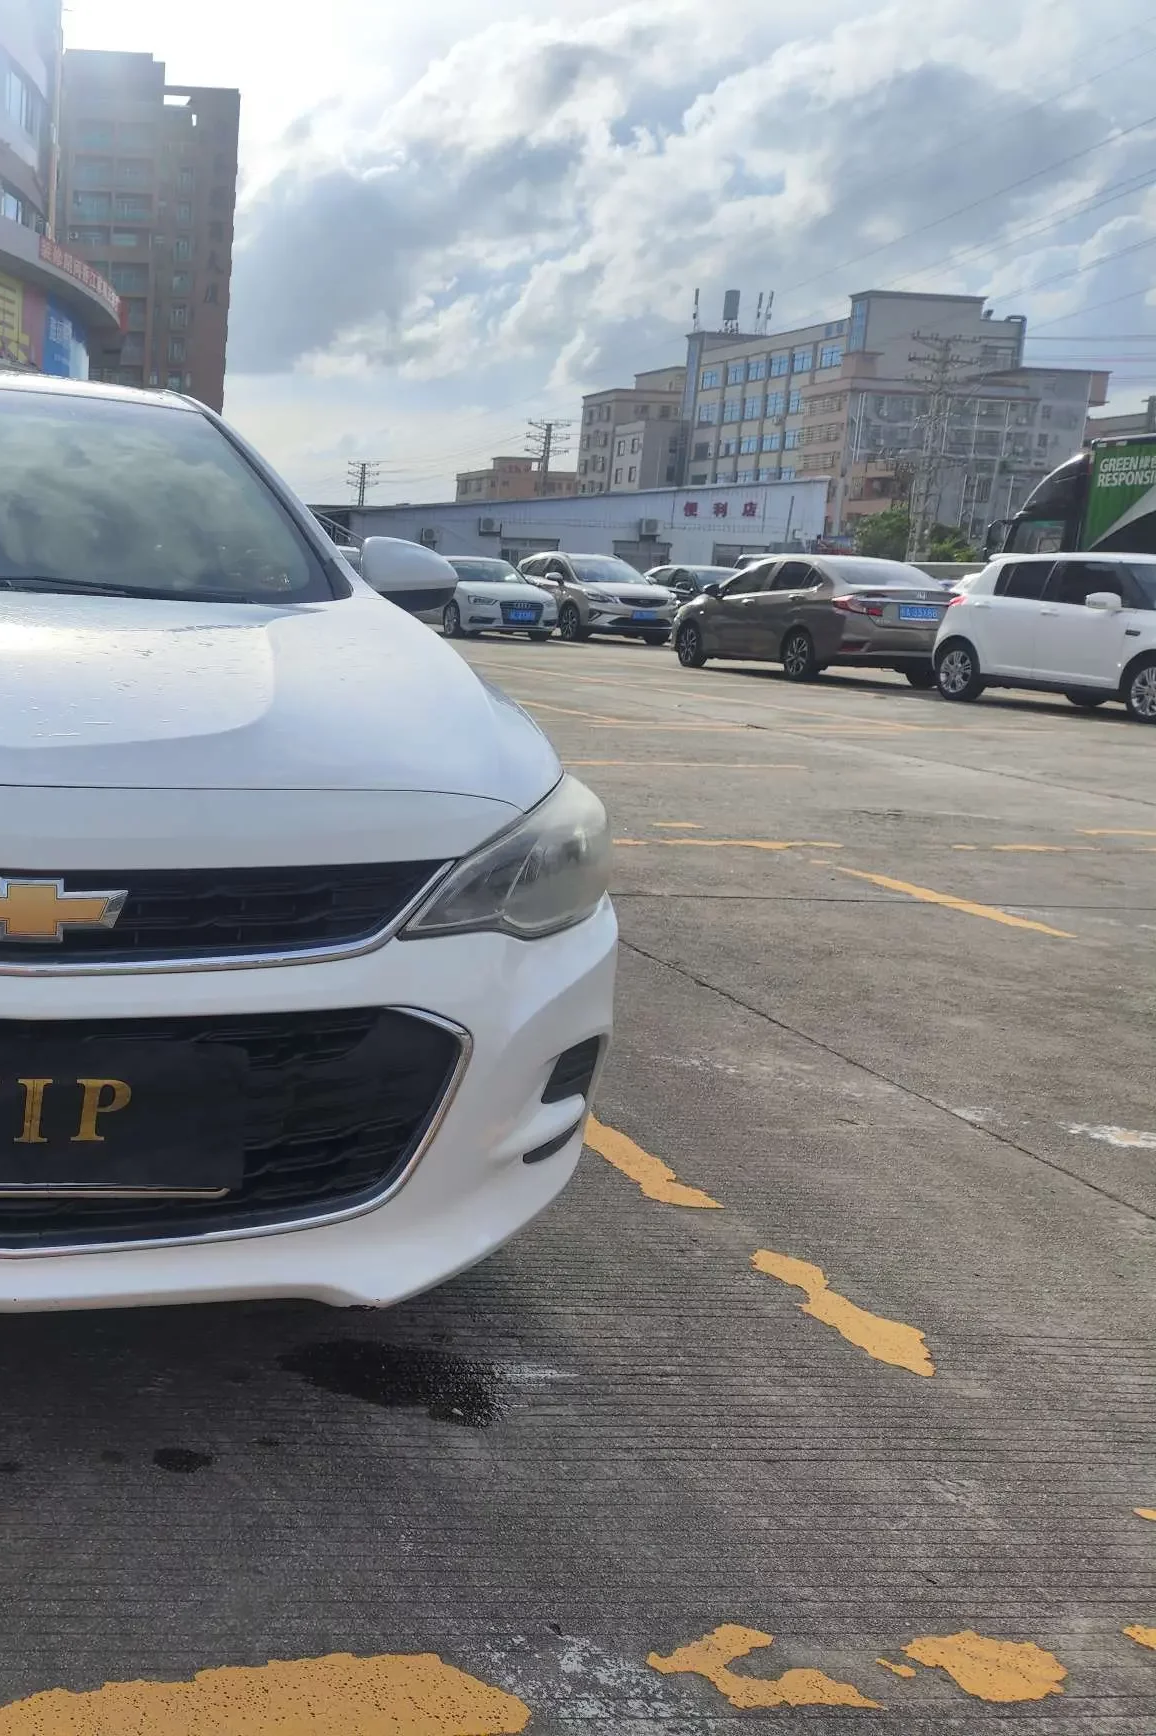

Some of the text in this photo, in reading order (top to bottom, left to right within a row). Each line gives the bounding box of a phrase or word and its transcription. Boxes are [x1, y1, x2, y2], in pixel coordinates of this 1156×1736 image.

[1100, 456, 1140, 473] GREEN
[684, 502, 758, 518] 便利店
